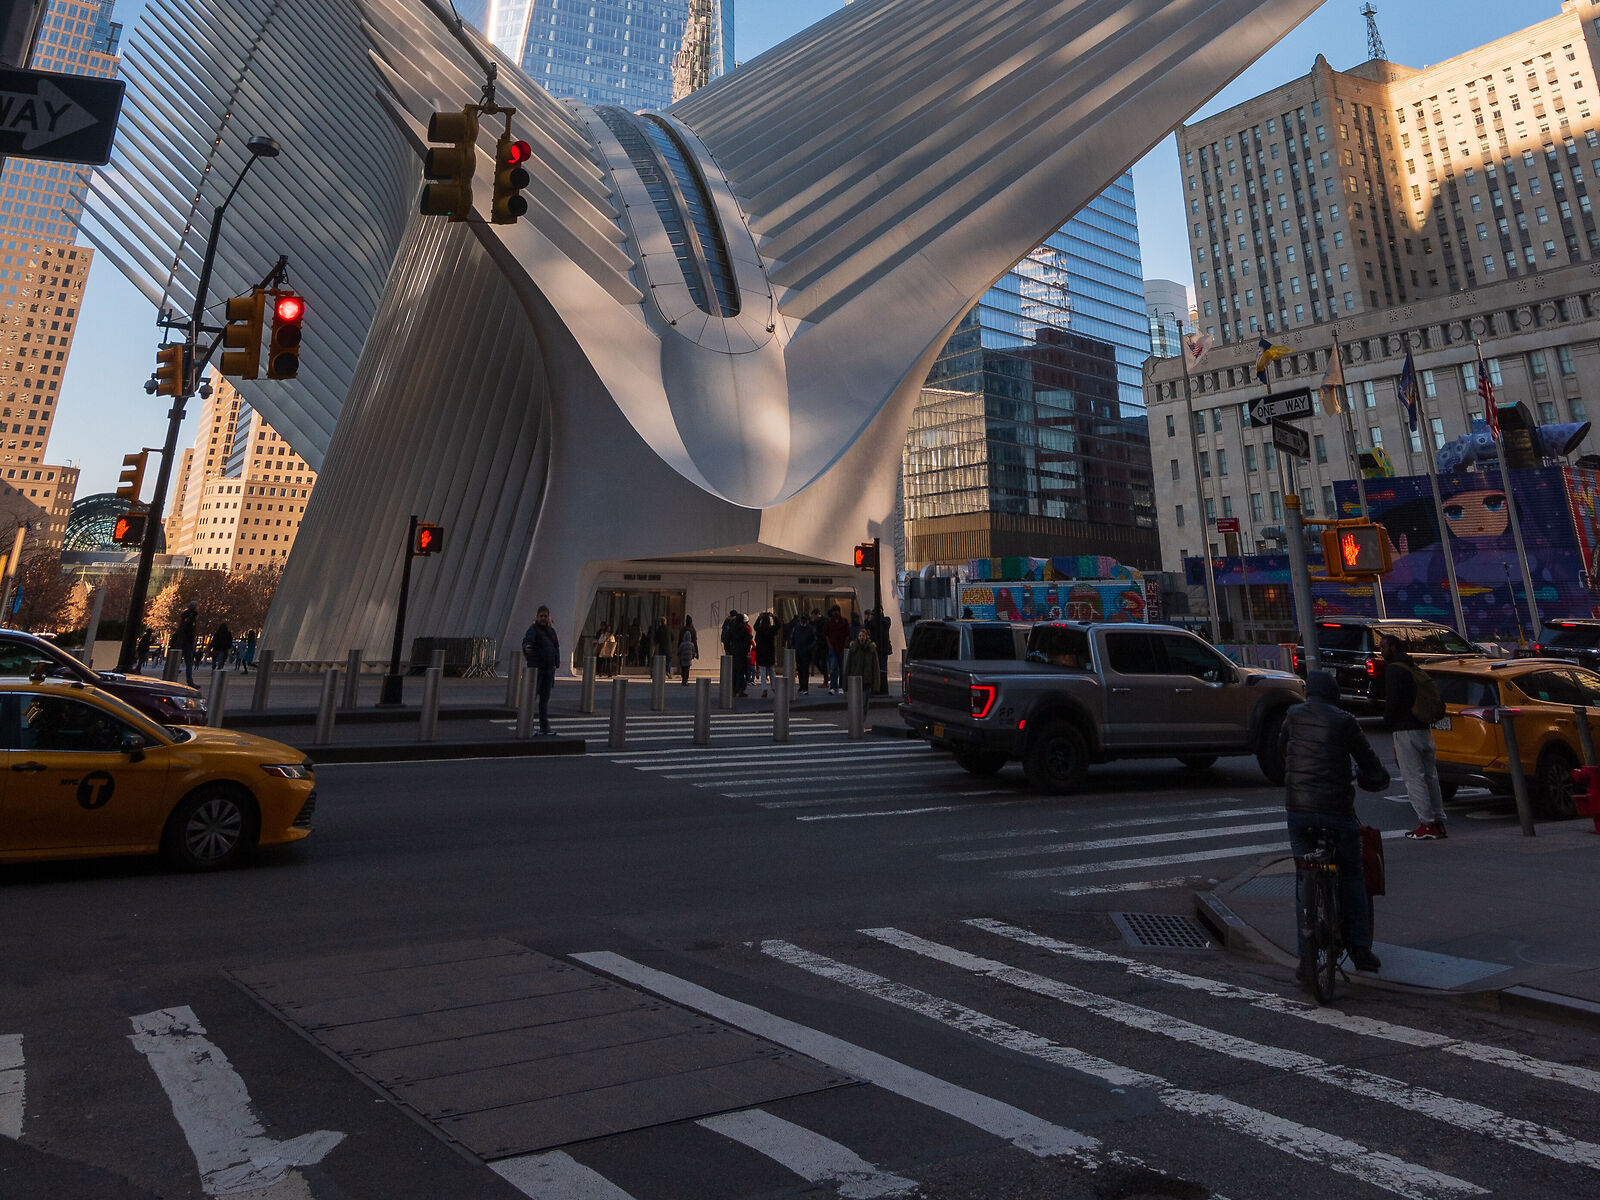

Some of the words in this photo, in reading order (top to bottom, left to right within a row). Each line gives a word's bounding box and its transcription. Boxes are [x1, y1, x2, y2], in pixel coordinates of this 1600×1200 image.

[1257, 404, 1276, 417] ONE
[1285, 397, 1306, 412] WAY
[1277, 429, 1288, 443] ONE
